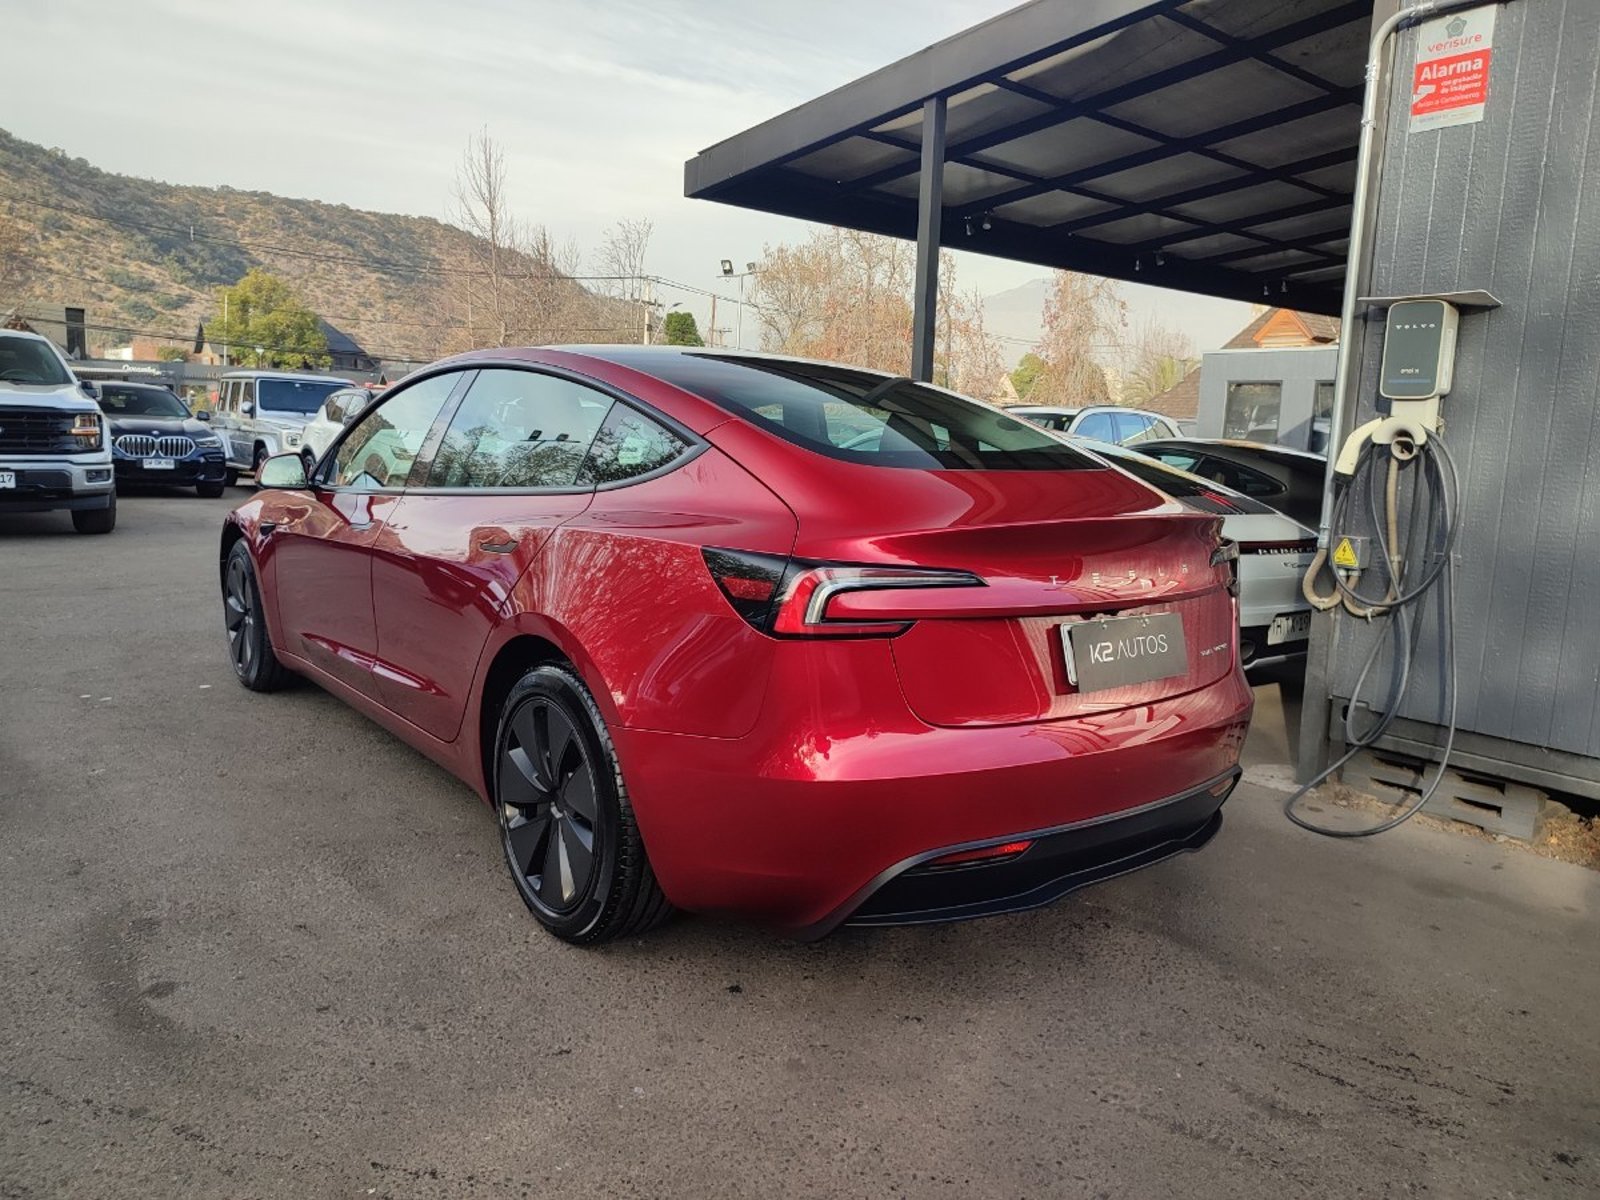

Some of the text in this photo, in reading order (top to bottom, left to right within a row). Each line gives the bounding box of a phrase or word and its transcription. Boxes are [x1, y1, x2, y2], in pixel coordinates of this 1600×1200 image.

[1427, 33, 1483, 53] verisure
[1420, 58, 1483, 81] Alarma
[1049, 564, 1189, 586] TESLA
[1089, 634, 1168, 664] K2 AUTOS
